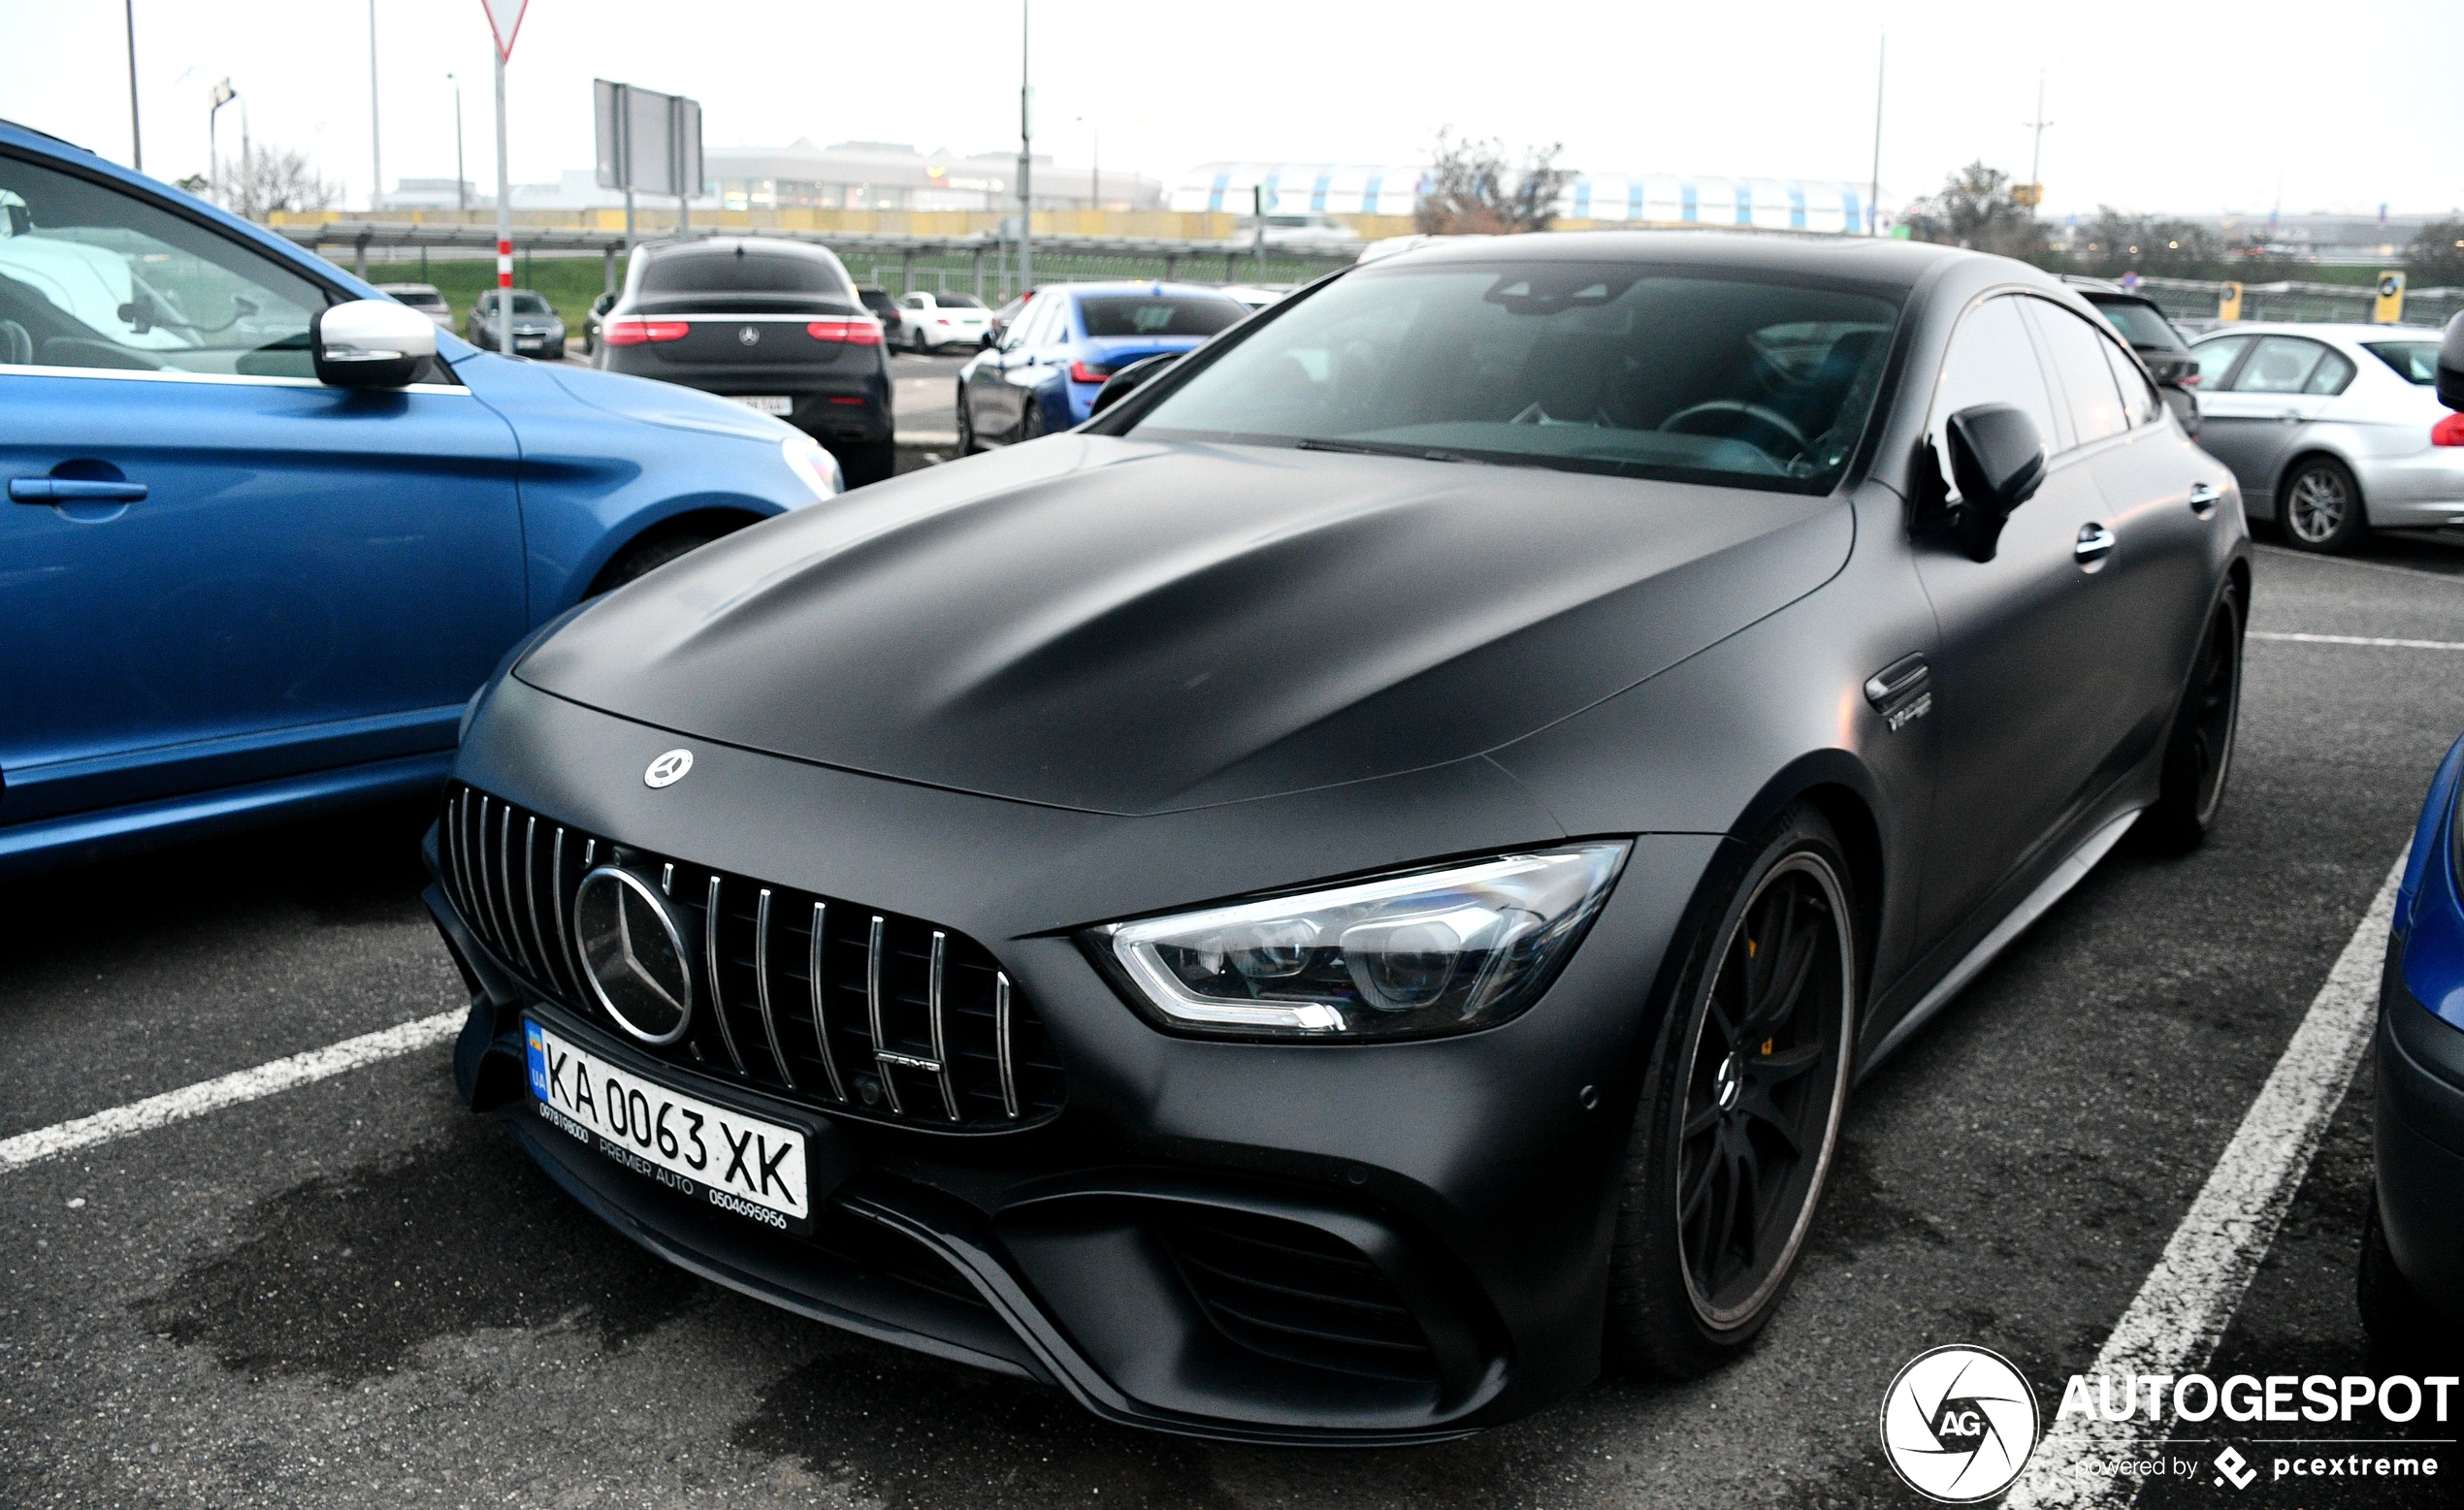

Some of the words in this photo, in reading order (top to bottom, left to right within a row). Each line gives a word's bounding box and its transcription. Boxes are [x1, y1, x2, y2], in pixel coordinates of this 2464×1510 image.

[531, 1069, 546, 1092] UA
[546, 1043, 600, 1124] KA
[605, 1077, 708, 1171] 0063
[720, 1120, 798, 1206] XK
[599, 1138, 652, 1177] PREMIER
[656, 1168, 695, 1196] AUTO
[708, 1188, 788, 1230] 0504695956
